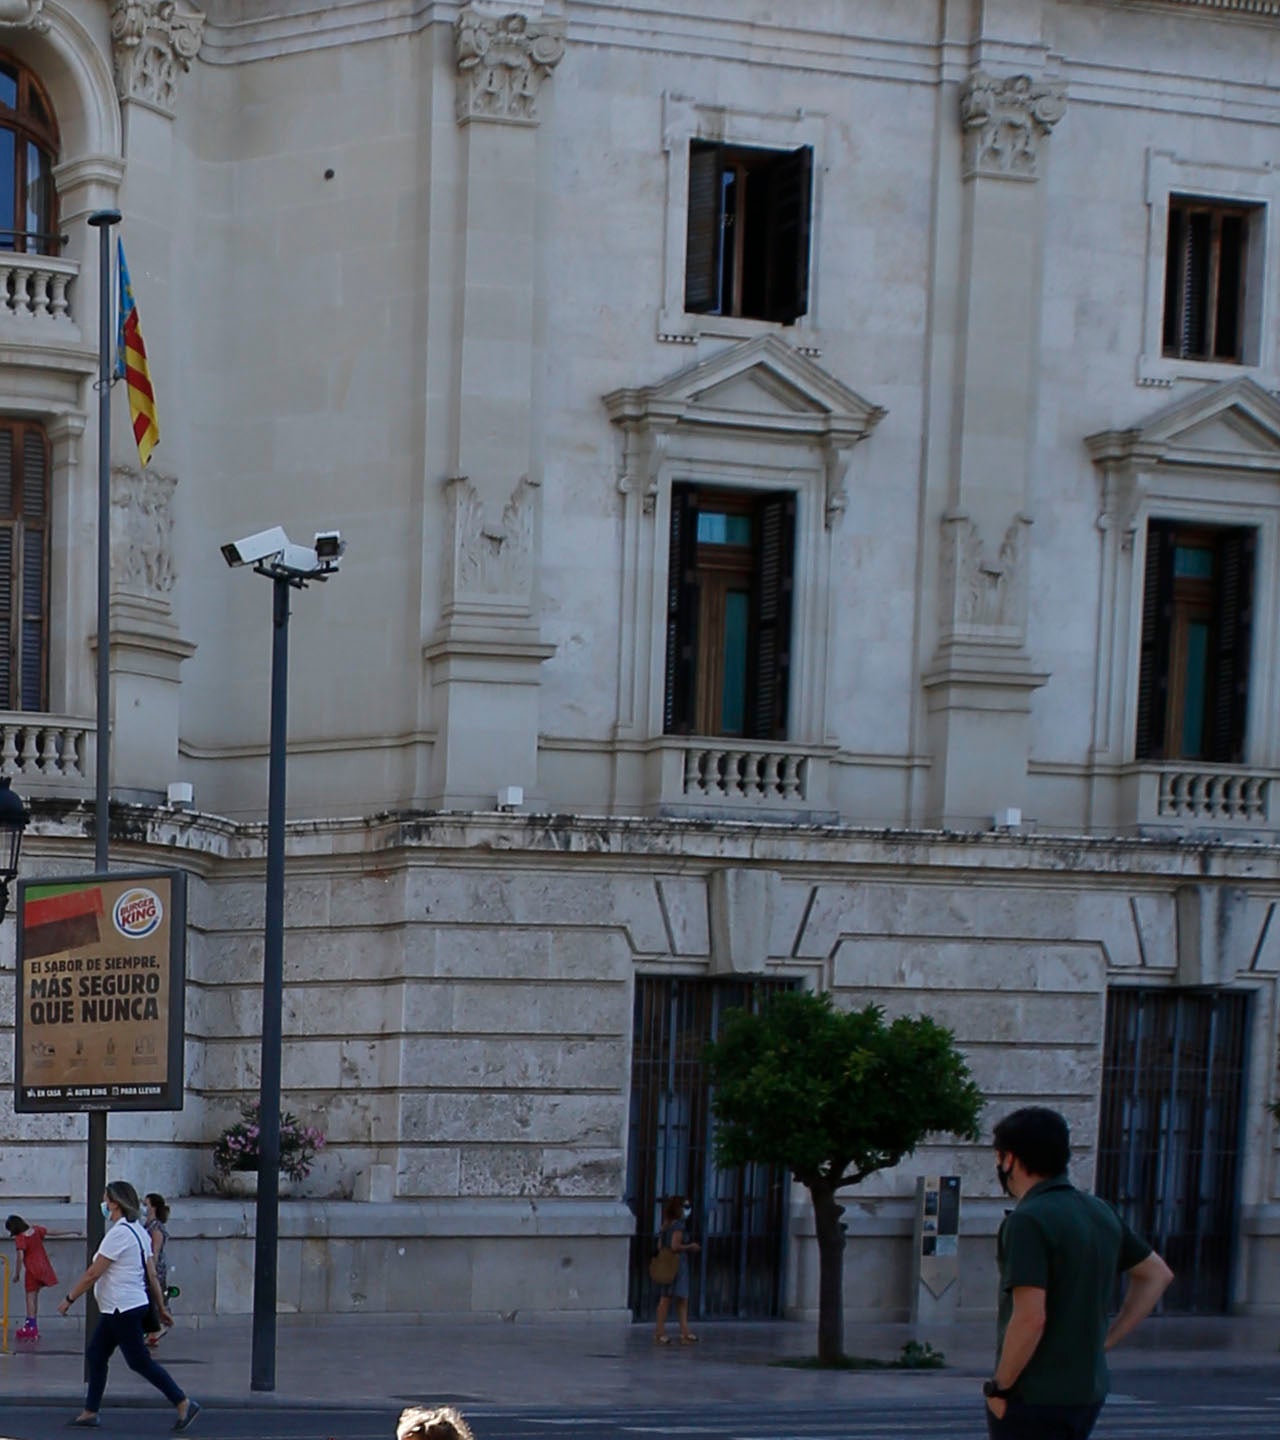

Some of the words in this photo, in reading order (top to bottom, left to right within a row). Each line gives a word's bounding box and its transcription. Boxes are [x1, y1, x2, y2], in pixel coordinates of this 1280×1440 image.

[119, 897, 155, 916] BURGER
[121, 905, 156, 928] KING
[44, 959, 83, 973] SABOR
[86, 958, 102, 971] DE
[104, 955, 161, 970] SIEMPRE,
[30, 973, 73, 999] MÁS
[79, 973, 161, 997] SEGURO
[30, 1000, 74, 1025] QUE
[81, 997, 159, 1023] NUNCA
